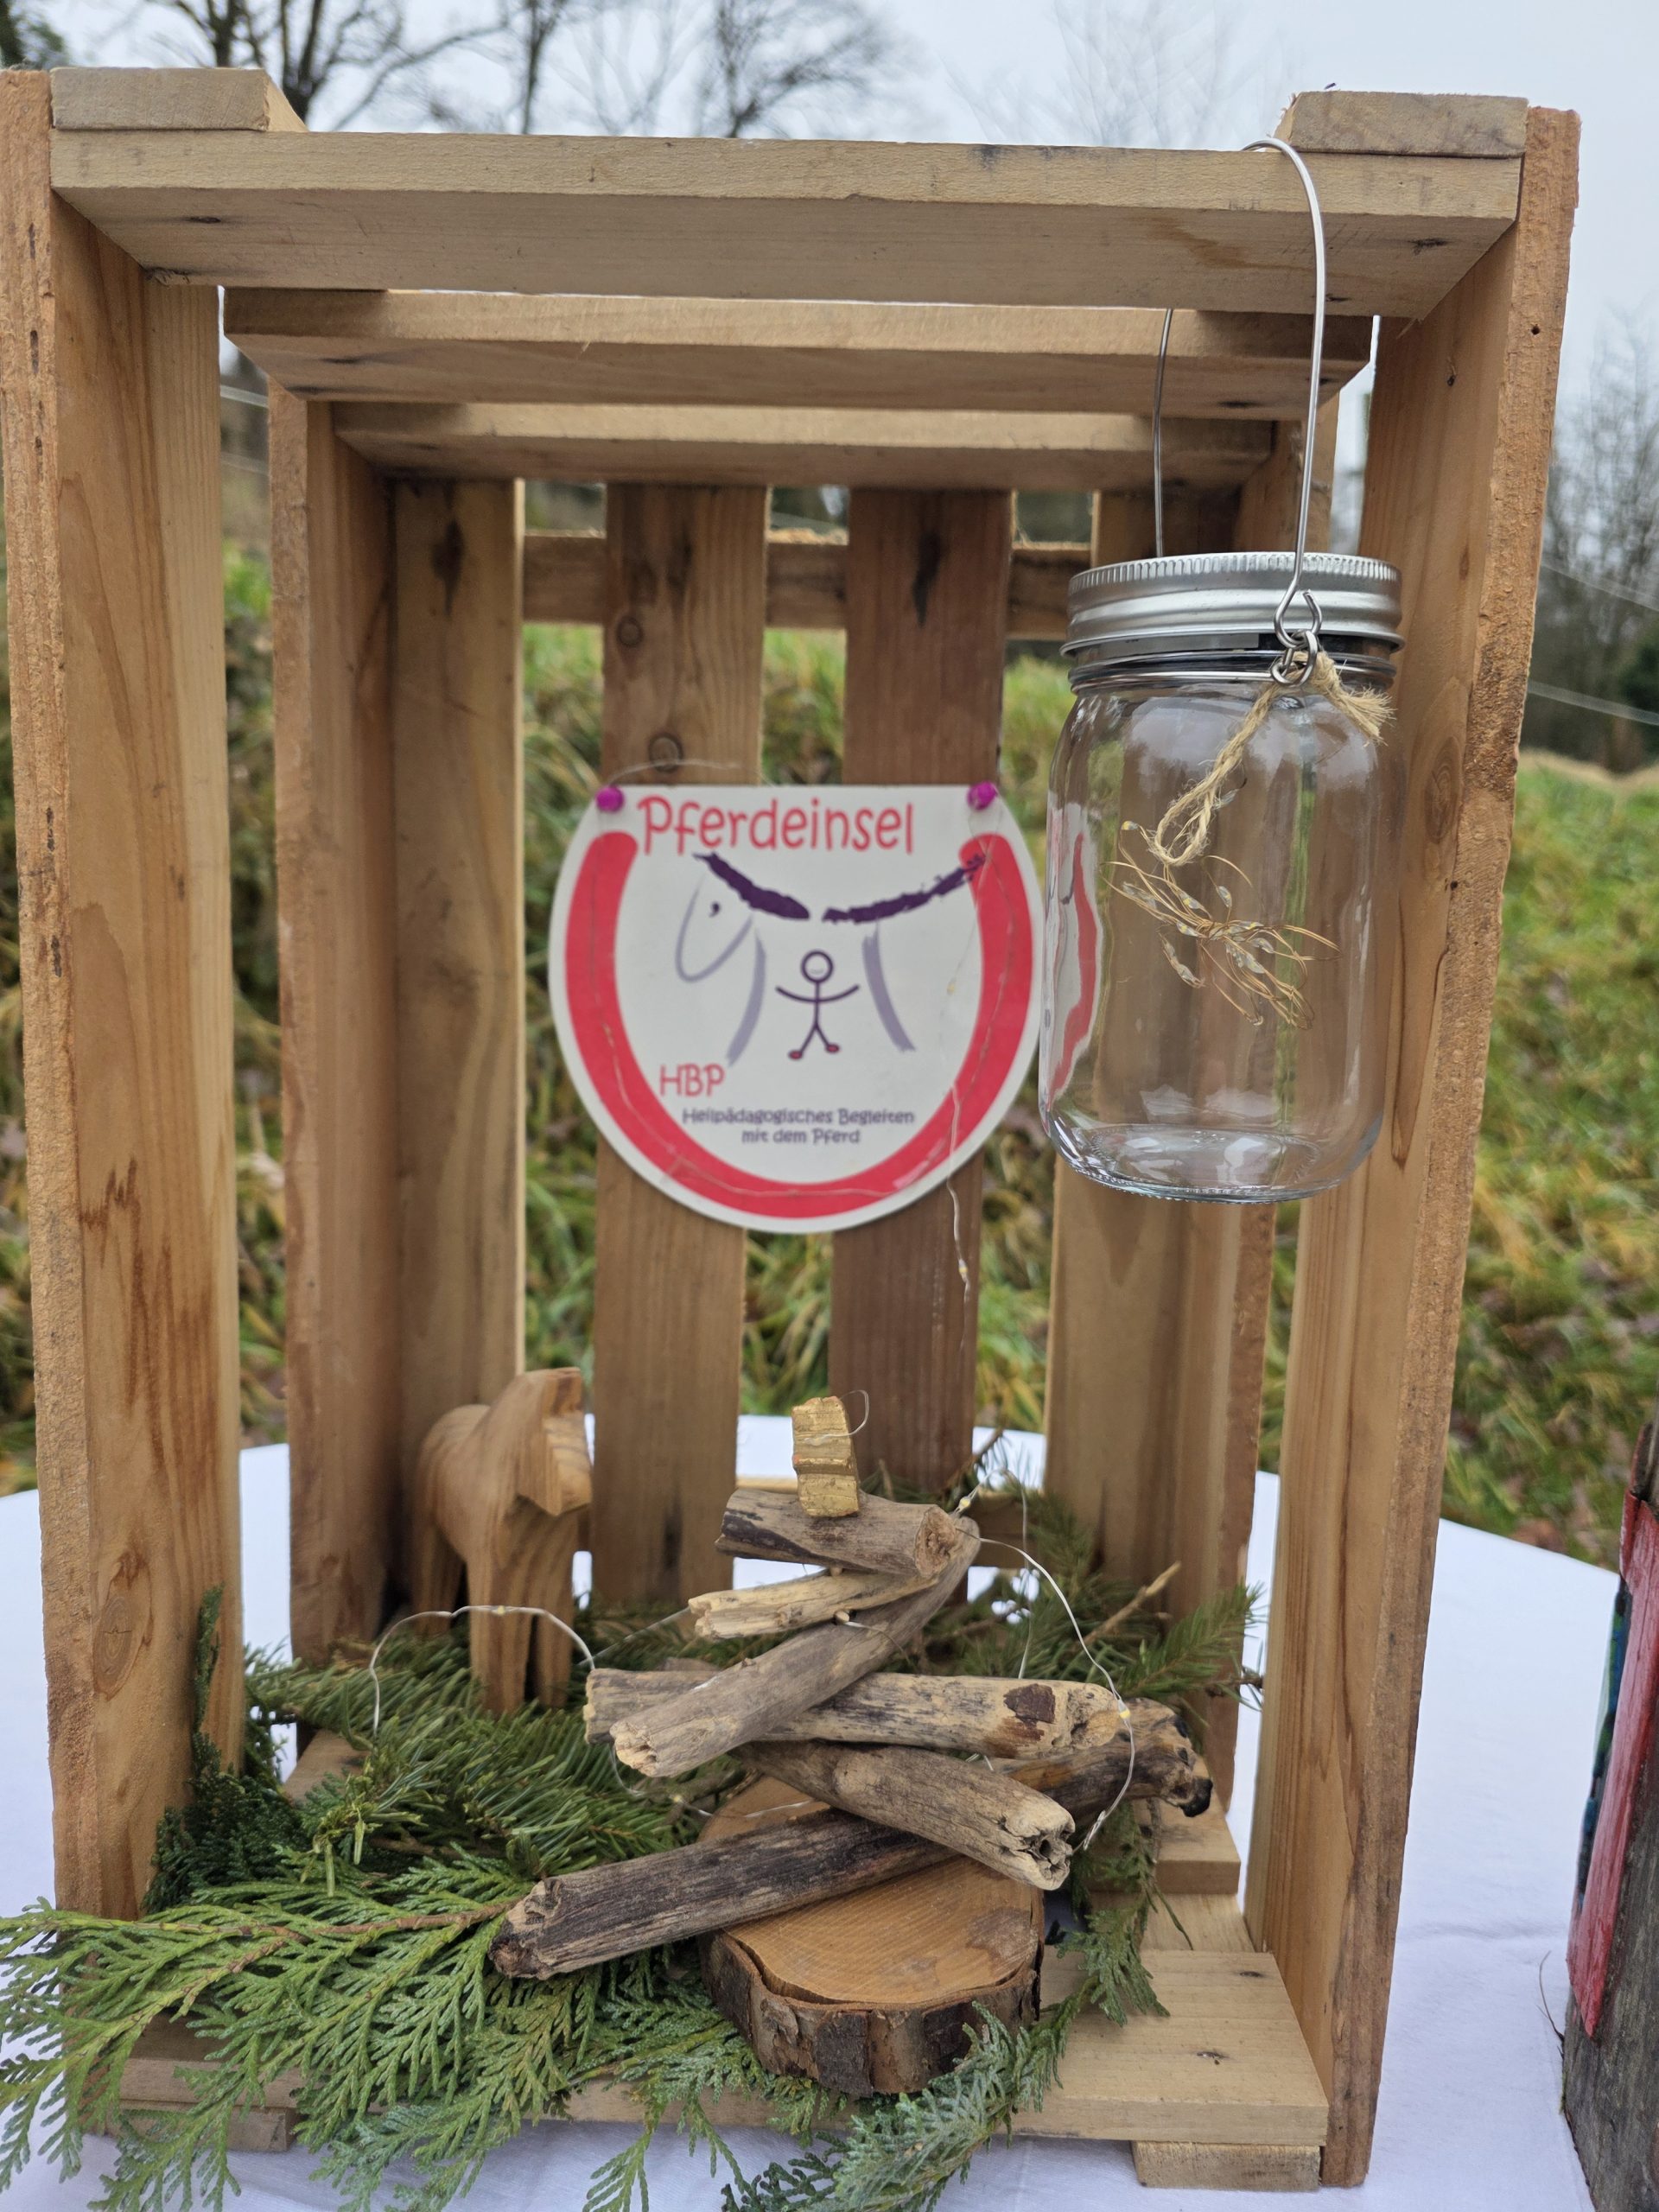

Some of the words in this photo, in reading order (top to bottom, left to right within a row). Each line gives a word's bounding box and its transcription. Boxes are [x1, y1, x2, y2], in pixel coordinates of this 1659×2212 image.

[638, 795, 914, 855] Pferdeinsel
[659, 1063, 725, 1097] HBP
[682, 1107, 833, 1125] Heilpädagogisches
[838, 1108, 915, 1125] Begleiten
[741, 1128, 768, 1143] mit
[772, 1128, 807, 1143] dem
[812, 1128, 861, 1143] Pferd
